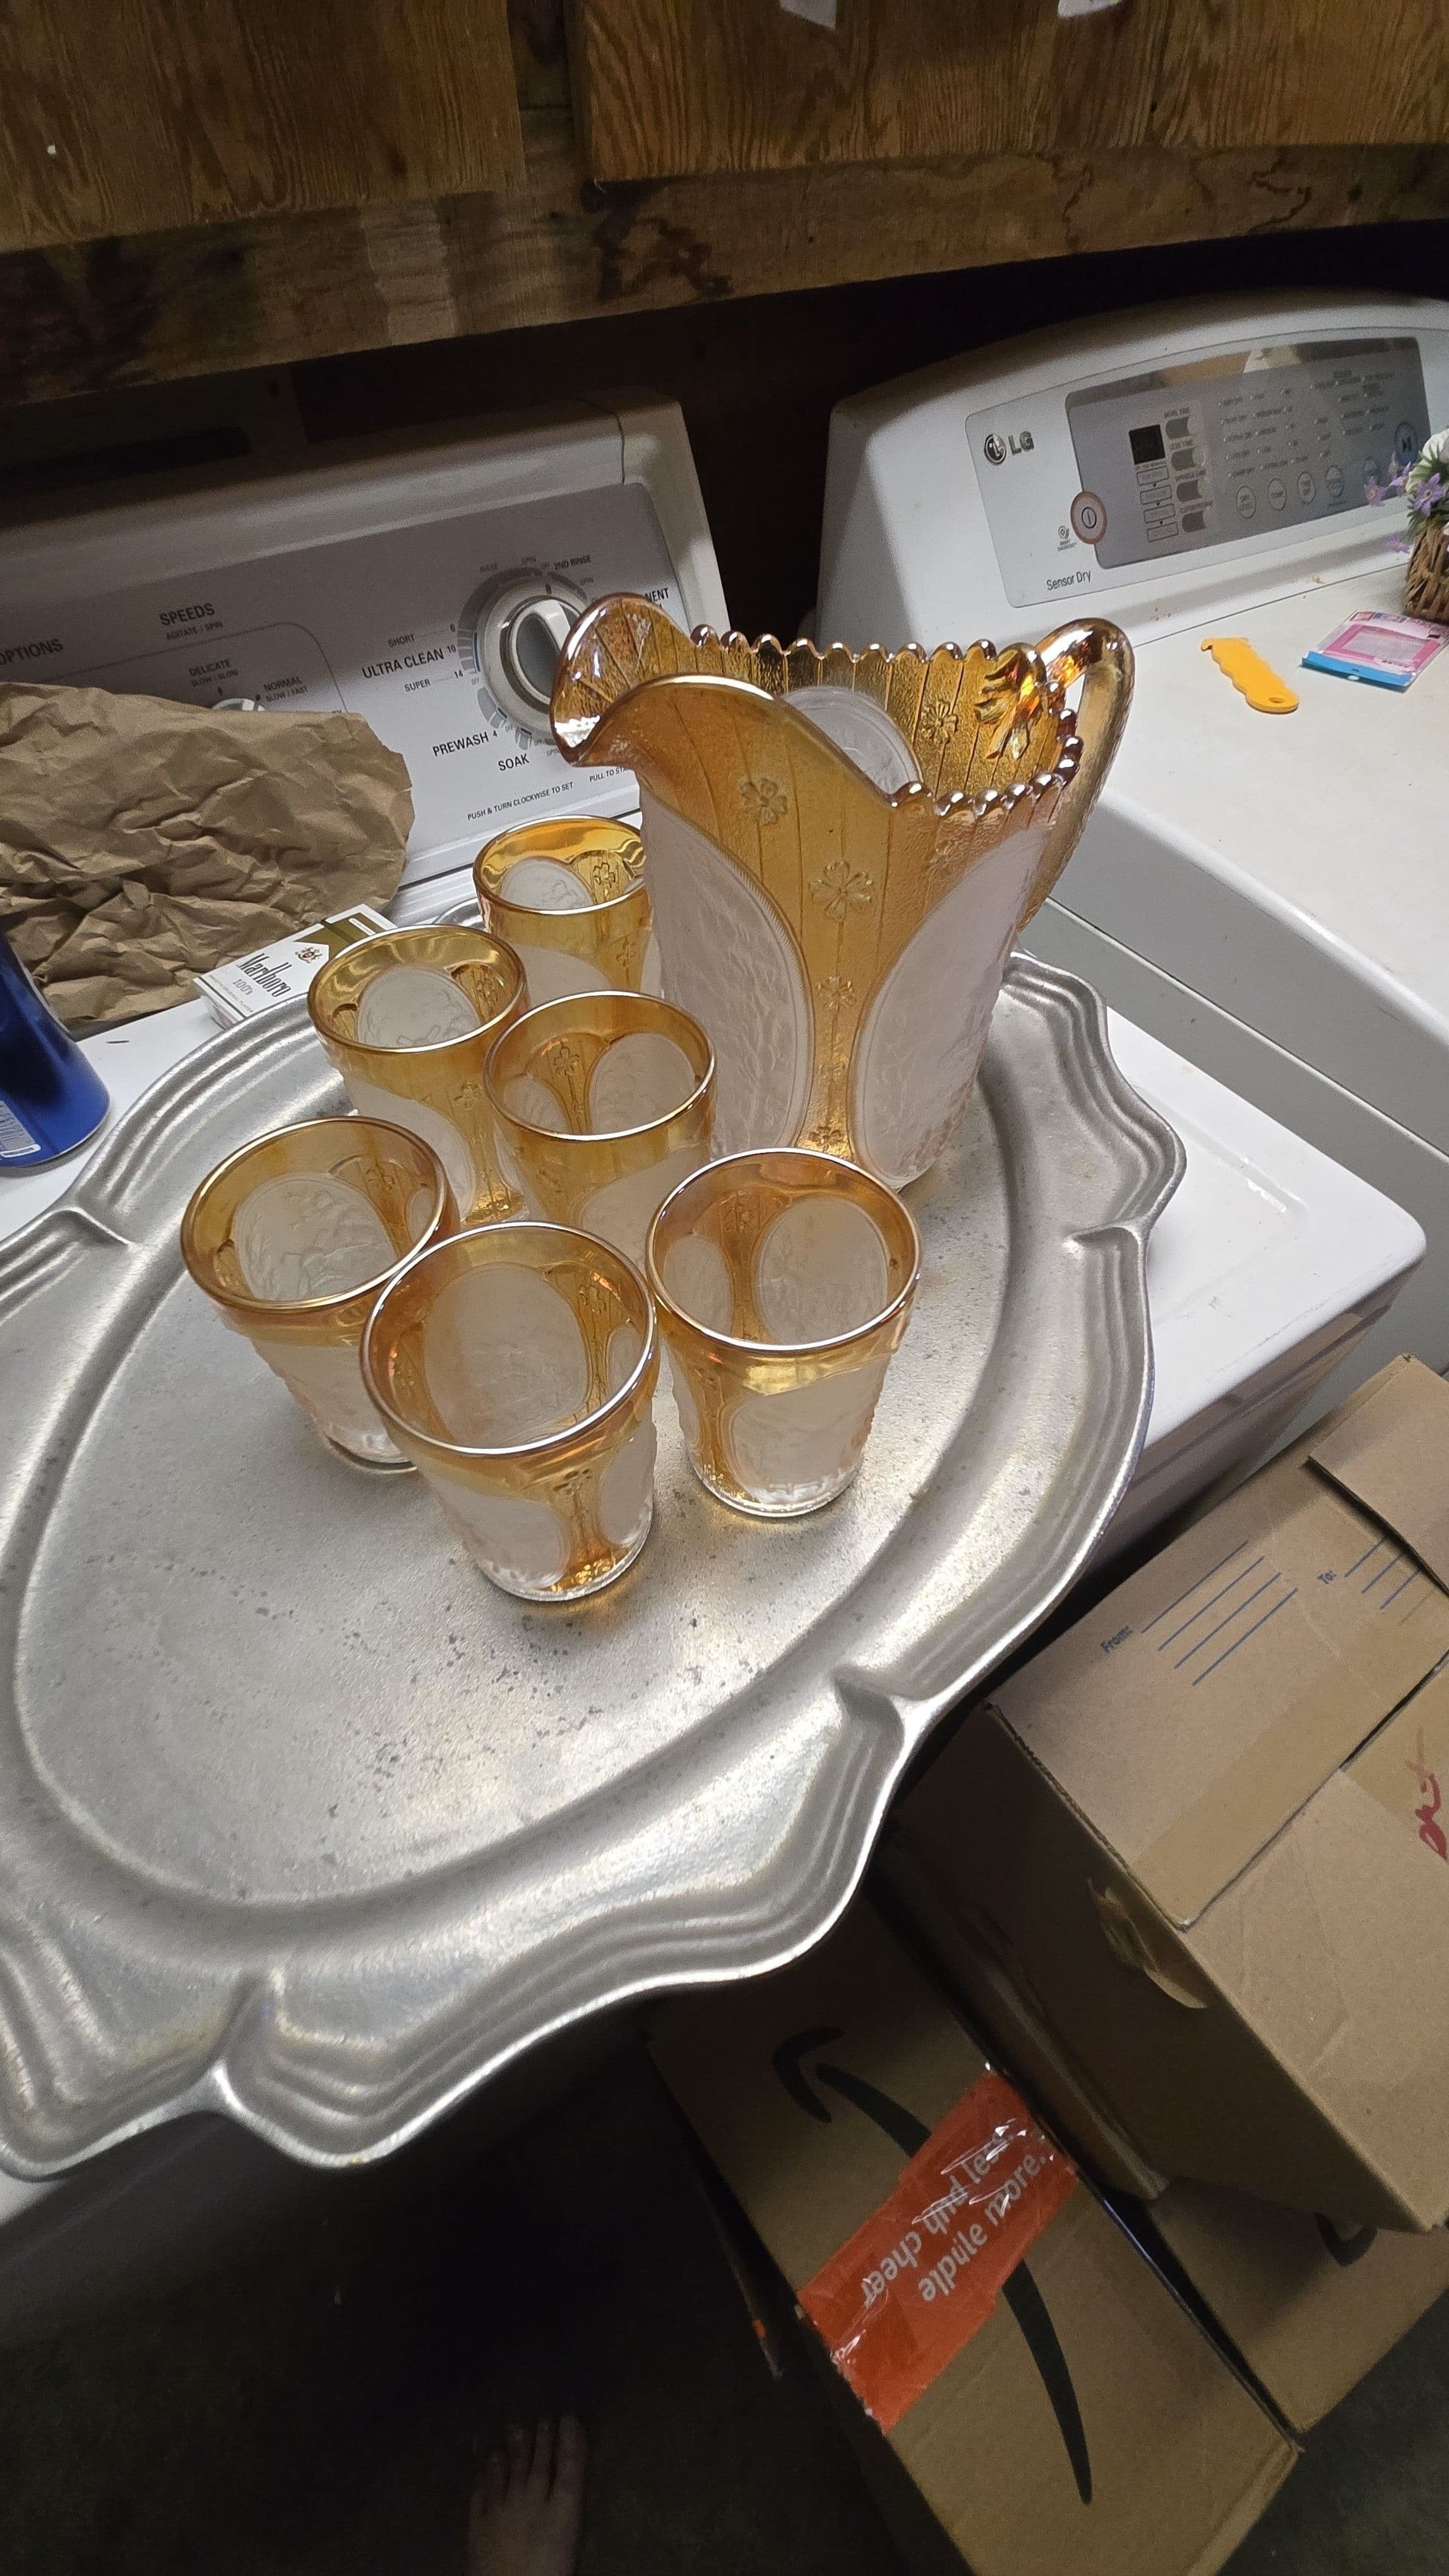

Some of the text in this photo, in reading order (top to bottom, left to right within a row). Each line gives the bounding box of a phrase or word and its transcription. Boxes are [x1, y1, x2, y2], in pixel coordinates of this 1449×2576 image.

[1010, 431, 1034, 455] LG
[554, 554, 592, 570] 2ND RINSE
[1046, 570, 1092, 591] Sensor Dry
[159, 602, 215, 626] SPEEDS
[388, 633, 415, 648] SHORT
[446, 644, 456, 654] 10
[0, 638, 64, 665] OPTIONS
[188, 657, 232, 677] DELICATE
[362, 648, 445, 680] ULTRA CLEAN
[454, 669, 463, 679] 14
[263, 675, 304, 693] NORMAL
[404, 677, 431, 693] SUPER
[432, 730, 489, 758] PREWASH
[497, 753, 530, 772] SOAK
[589, 772, 605, 782] PULL
[605, 769, 614, 777] TO
[467, 810, 486, 821] PUSH
[494, 801, 512, 812] TURN
[513, 789, 550, 807] CLOCKWISE
[551, 785, 561, 794] TO
[561, 781, 574, 791] SET
[236, 953, 292, 998] Marlboro
[232, 979, 254, 996] 100's
[984, 2154, 1047, 2227] more.
[861, 2231, 922, 2308] cheer
